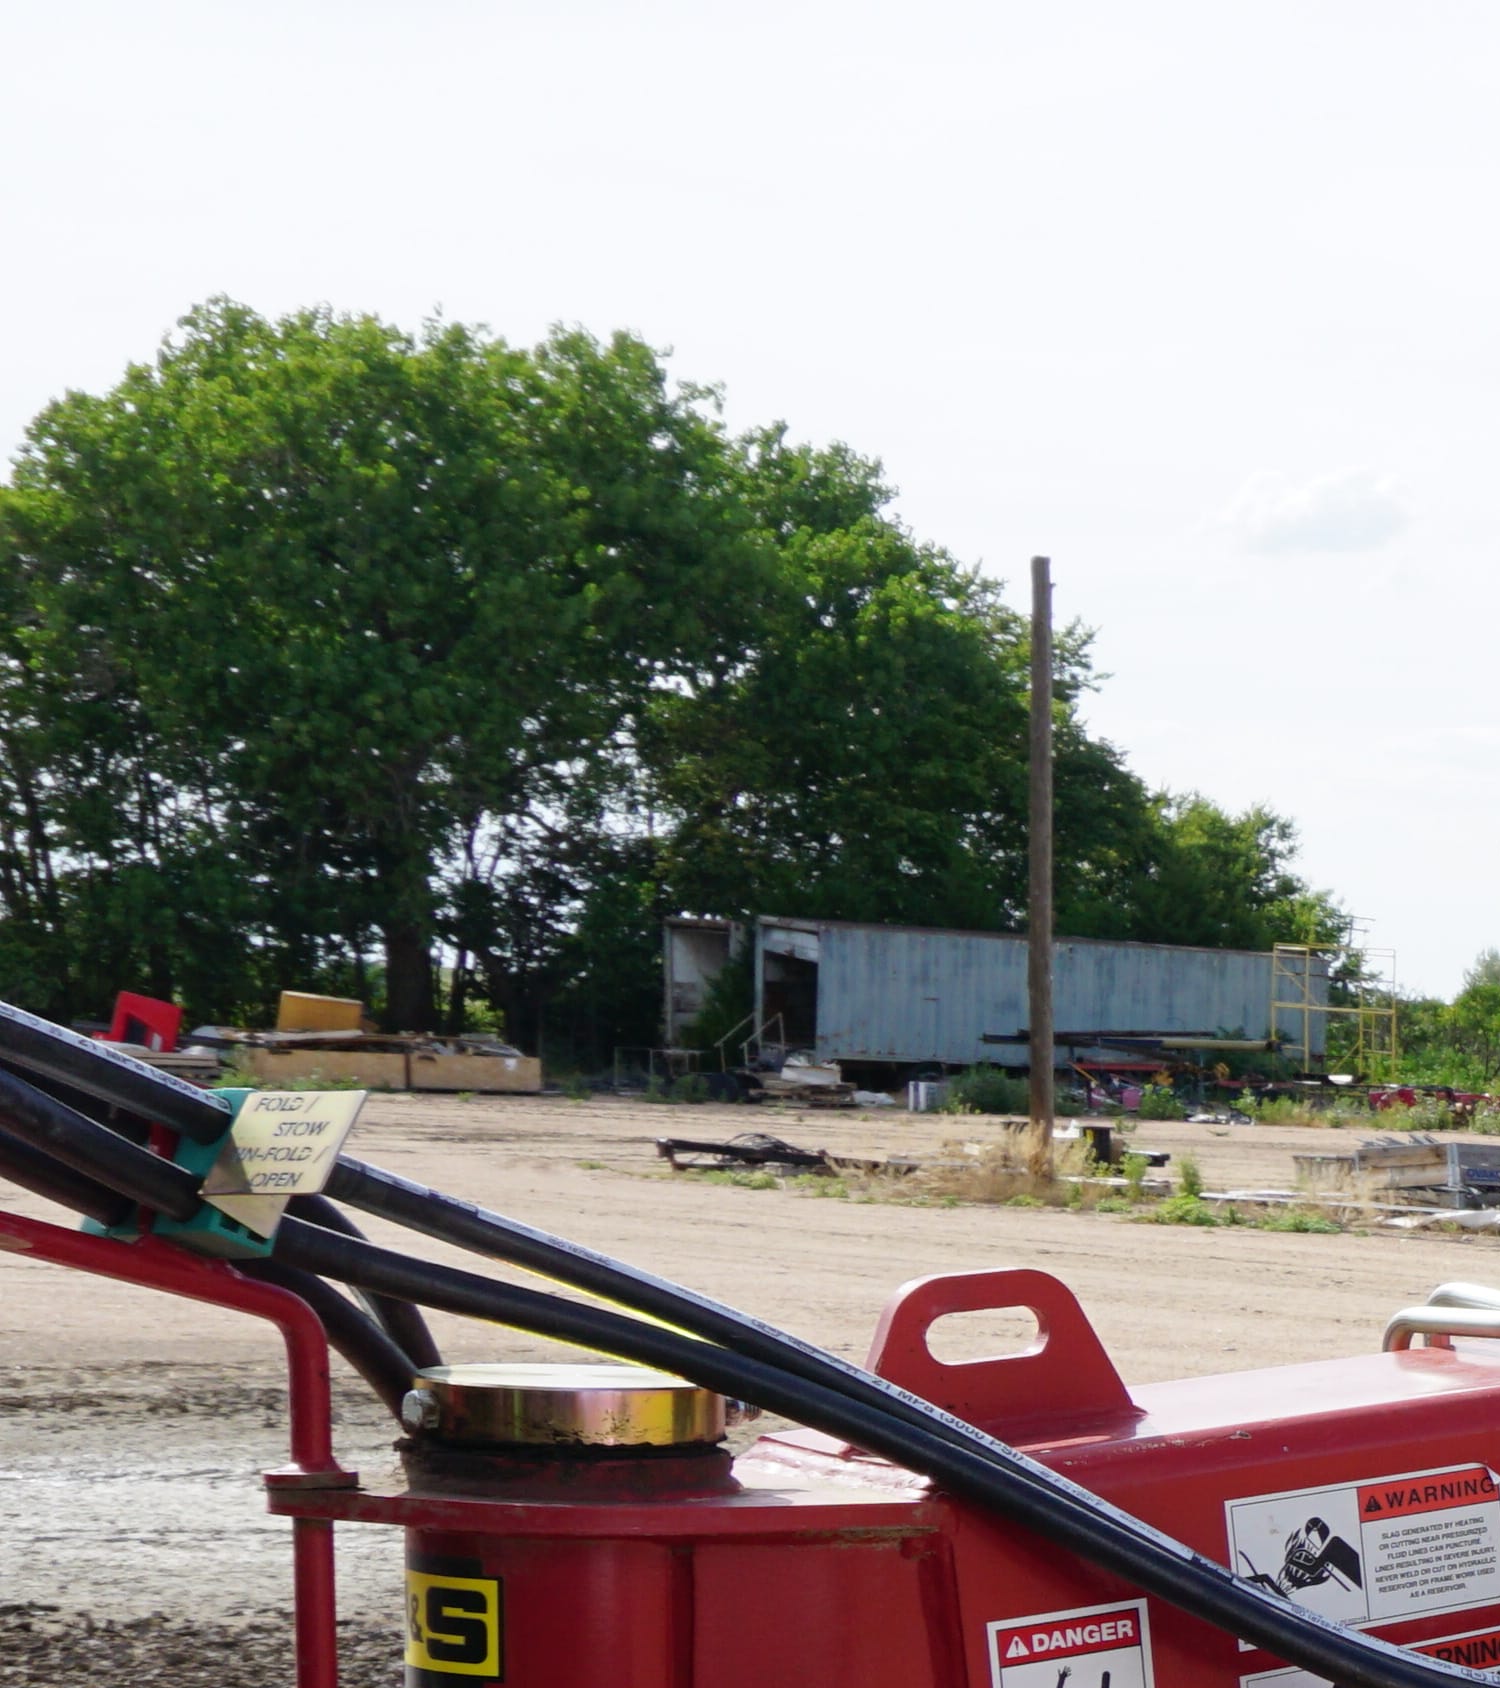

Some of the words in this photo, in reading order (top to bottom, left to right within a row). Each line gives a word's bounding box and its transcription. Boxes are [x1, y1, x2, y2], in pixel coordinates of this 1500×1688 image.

[255, 1097, 304, 1112] FOLD
[273, 1122, 329, 1136] STOW
[250, 1173, 303, 1187] OPEN
[897, 1390, 934, 1415] MPa
[1386, 1477, 1495, 1508] WARNING
[1382, 1531, 1400, 1539] SLAG
[1402, 1524, 1443, 1536] GENERATED
[1455, 1517, 1484, 1527] HEATING
[1391, 1539, 1420, 1549] CUTTING
[1422, 1535, 1440, 1543] NEAR
[1442, 1527, 1487, 1540] PRESSURIZED
[1409, 1548, 1428, 1556] LINES
[1429, 1544, 1444, 1552] CAN
[1375, 1564, 1394, 1572] LINES
[1396, 1557, 1433, 1569] RESULTING
[1444, 1551, 1469, 1561] SEVERE
[1376, 1574, 1398, 1583] NEVER
[1400, 1570, 1419, 1579] WELD
[1432, 1565, 1446, 1574] CUT
[1459, 1557, 1496, 1569] HYDRAULIC
[1379, 1581, 1417, 1593] RESERVOIR
[1431, 1575, 1453, 1584] FRAME
[1455, 1572, 1475, 1580] WORK
[1477, 1568, 1495, 1576] USED
[405, 1586, 487, 1664] &S
[1032, 1620, 1134, 1652] DANGER
